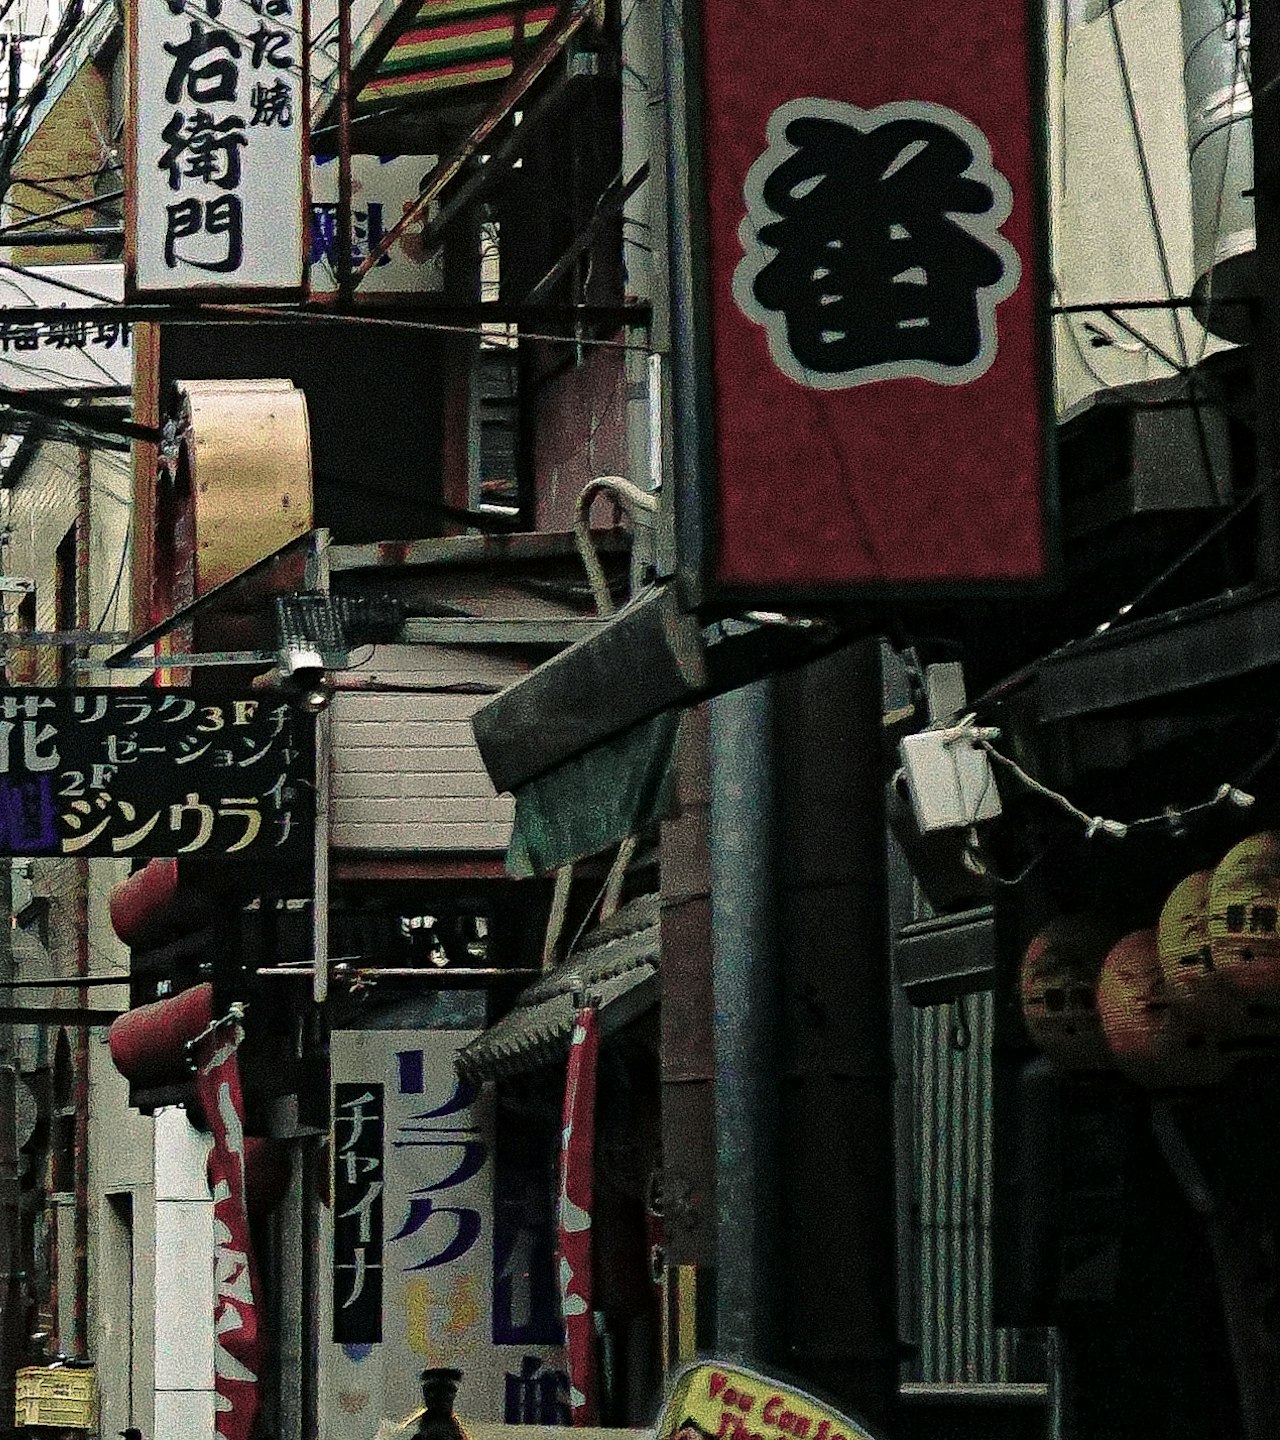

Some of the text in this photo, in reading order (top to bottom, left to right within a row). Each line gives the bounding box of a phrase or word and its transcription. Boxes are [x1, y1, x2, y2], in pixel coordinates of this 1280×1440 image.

[72, 694, 196, 726] リラク
[196, 699, 260, 733] 3F
[102, 731, 274, 769] ゼーション
[58, 763, 119, 797] 2F
[59, 792, 264, 855] ジンウラ
[334, 1091, 384, 1310] チャイナ
